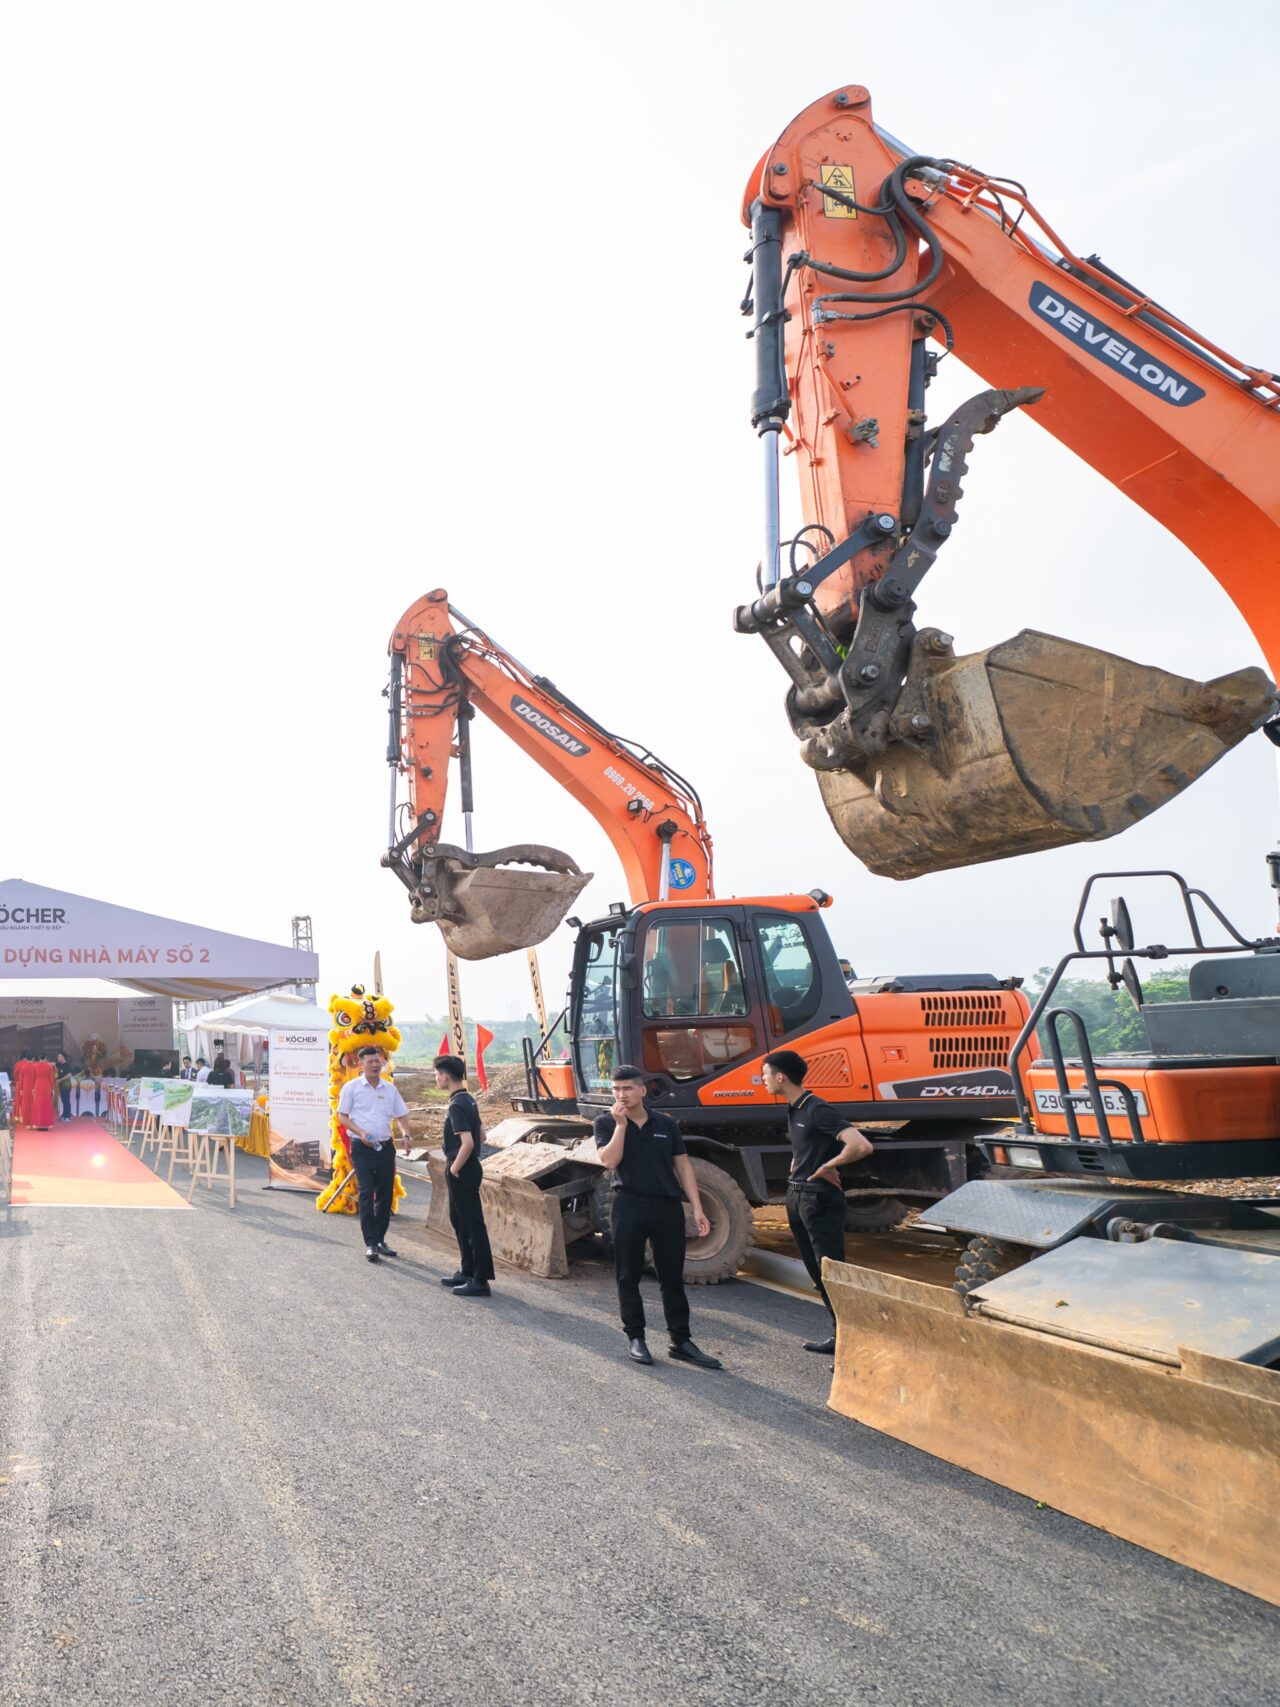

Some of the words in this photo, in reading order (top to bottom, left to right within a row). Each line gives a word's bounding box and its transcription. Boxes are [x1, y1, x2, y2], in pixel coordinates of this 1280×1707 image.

[1038, 295, 1188, 401] DEVELON
[514, 704, 583, 752] DOOSAN
[4, 946, 63, 968] DỰNG
[69, 945, 111, 963] NHÀ
[117, 944, 160, 963] MÁY
[166, 943, 194, 964] SỐ
[199, 949, 210, 963] 2
[286, 1035, 318, 1043] KÖCHER
